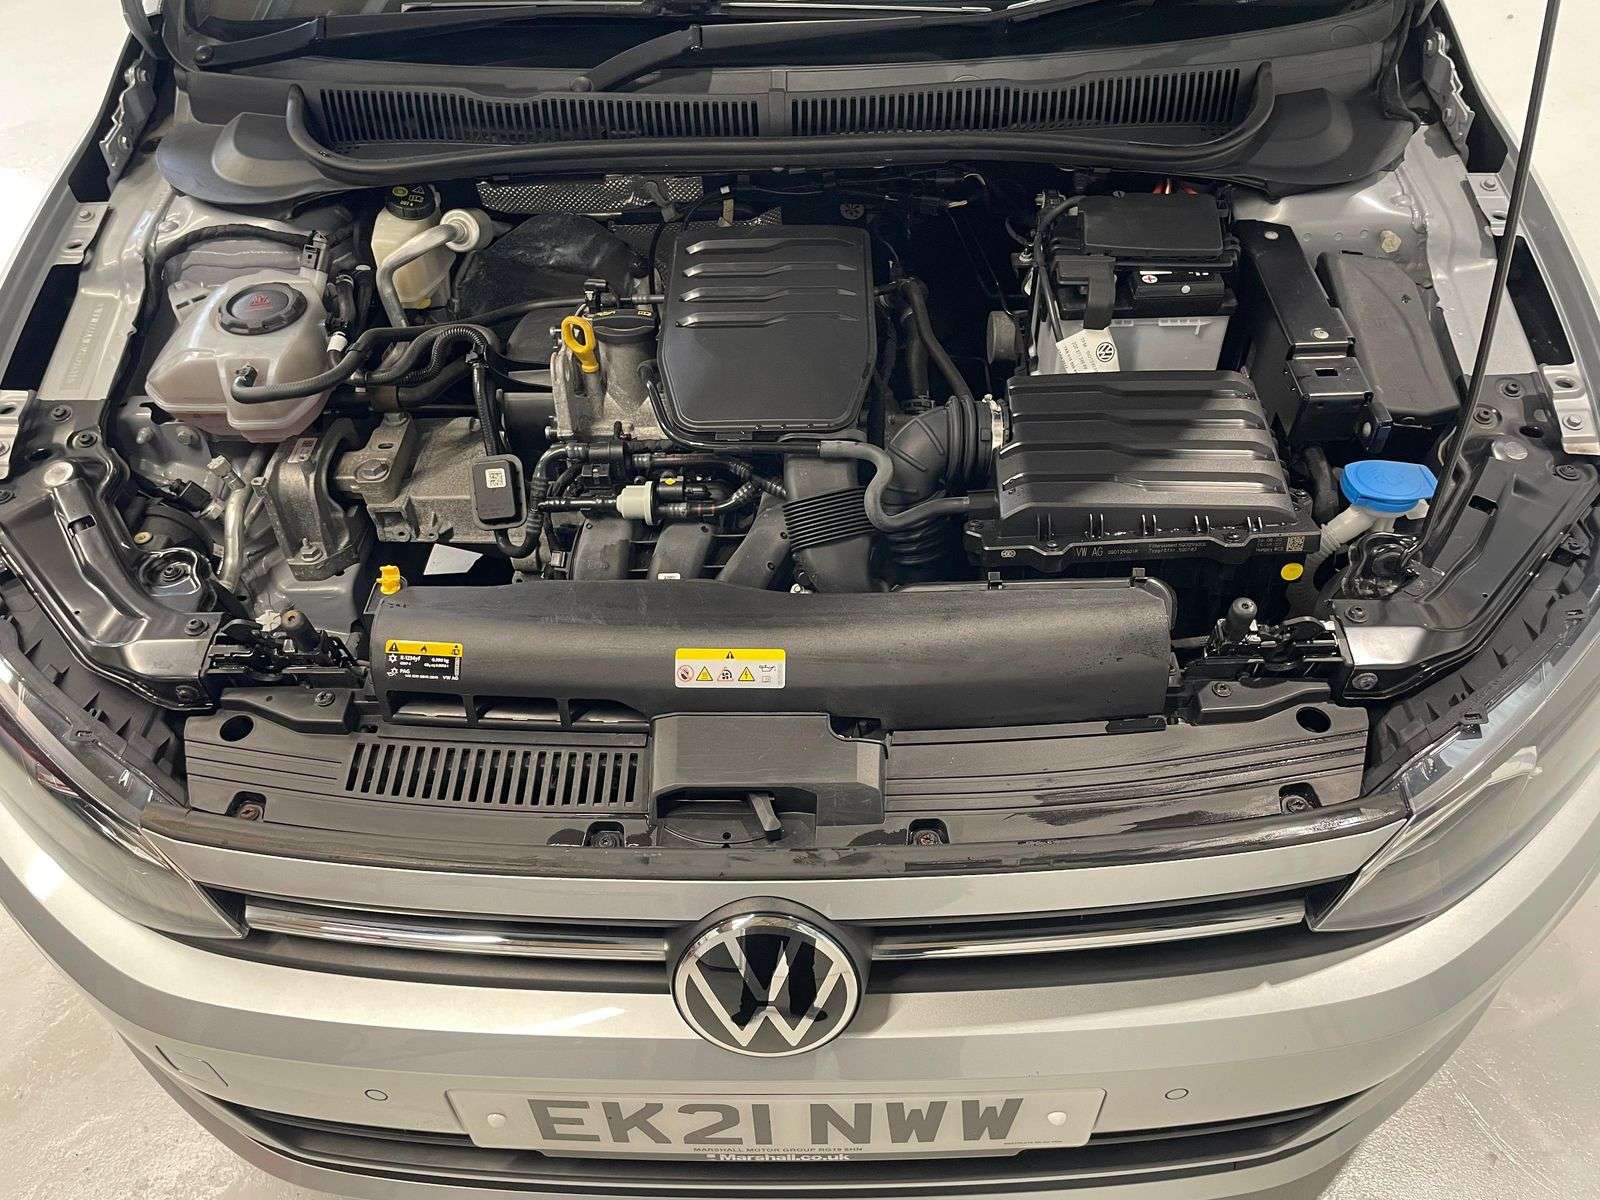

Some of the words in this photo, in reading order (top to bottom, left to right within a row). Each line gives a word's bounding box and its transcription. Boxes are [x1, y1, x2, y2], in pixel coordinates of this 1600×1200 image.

[1076, 548, 1088, 557] VW
[1092, 547, 1104, 557] AG
[527, 1098, 774, 1146] EK21
[809, 1097, 1024, 1146] NWW
[719, 1152, 851, 1161] Marshall.co.uk
